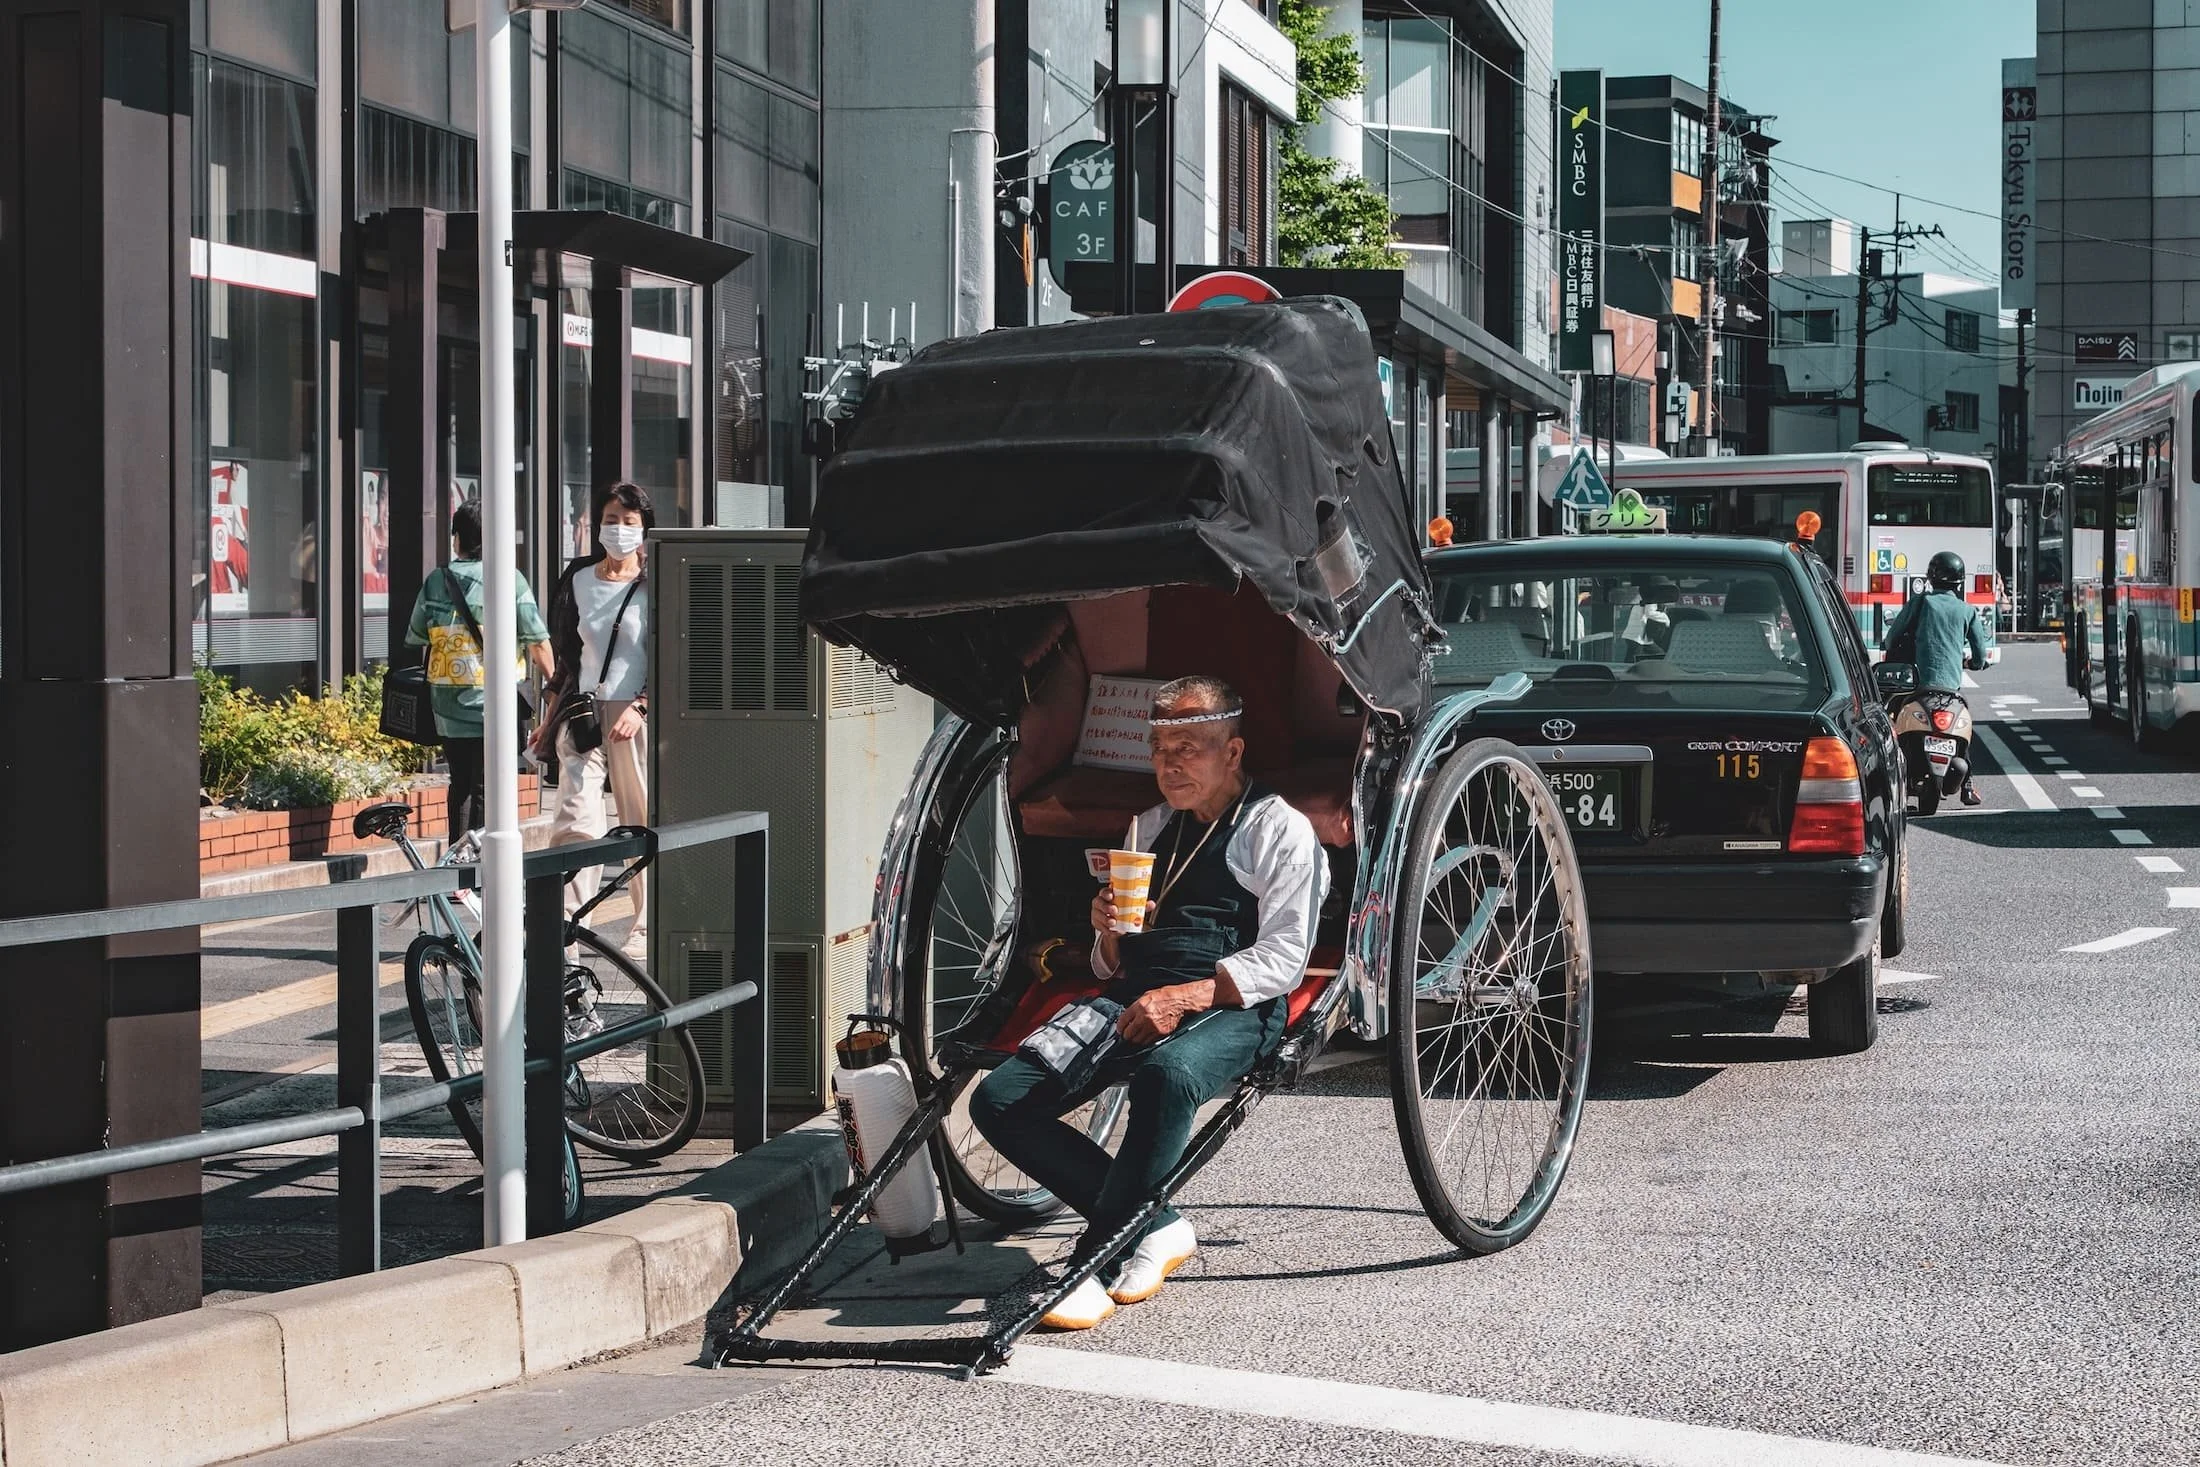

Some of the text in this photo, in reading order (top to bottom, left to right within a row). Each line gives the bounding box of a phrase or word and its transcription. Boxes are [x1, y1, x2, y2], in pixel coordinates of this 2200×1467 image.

[1571, 132, 1588, 197] SMBC
[1055, 200, 1108, 218] CAF
[2003, 127, 2031, 280] Tokyu Store
[1076, 232, 1106, 255] 3F
[1565, 229, 1579, 334] SMBC日興証券
[1580, 229, 1594, 309] 三井住友銀行
[1042, 276, 1053, 307] 2F
[1596, 512, 1658, 527] グリン
[1716, 753, 1760, 779] 115
[1545, 773, 1594, 790] 浜500
